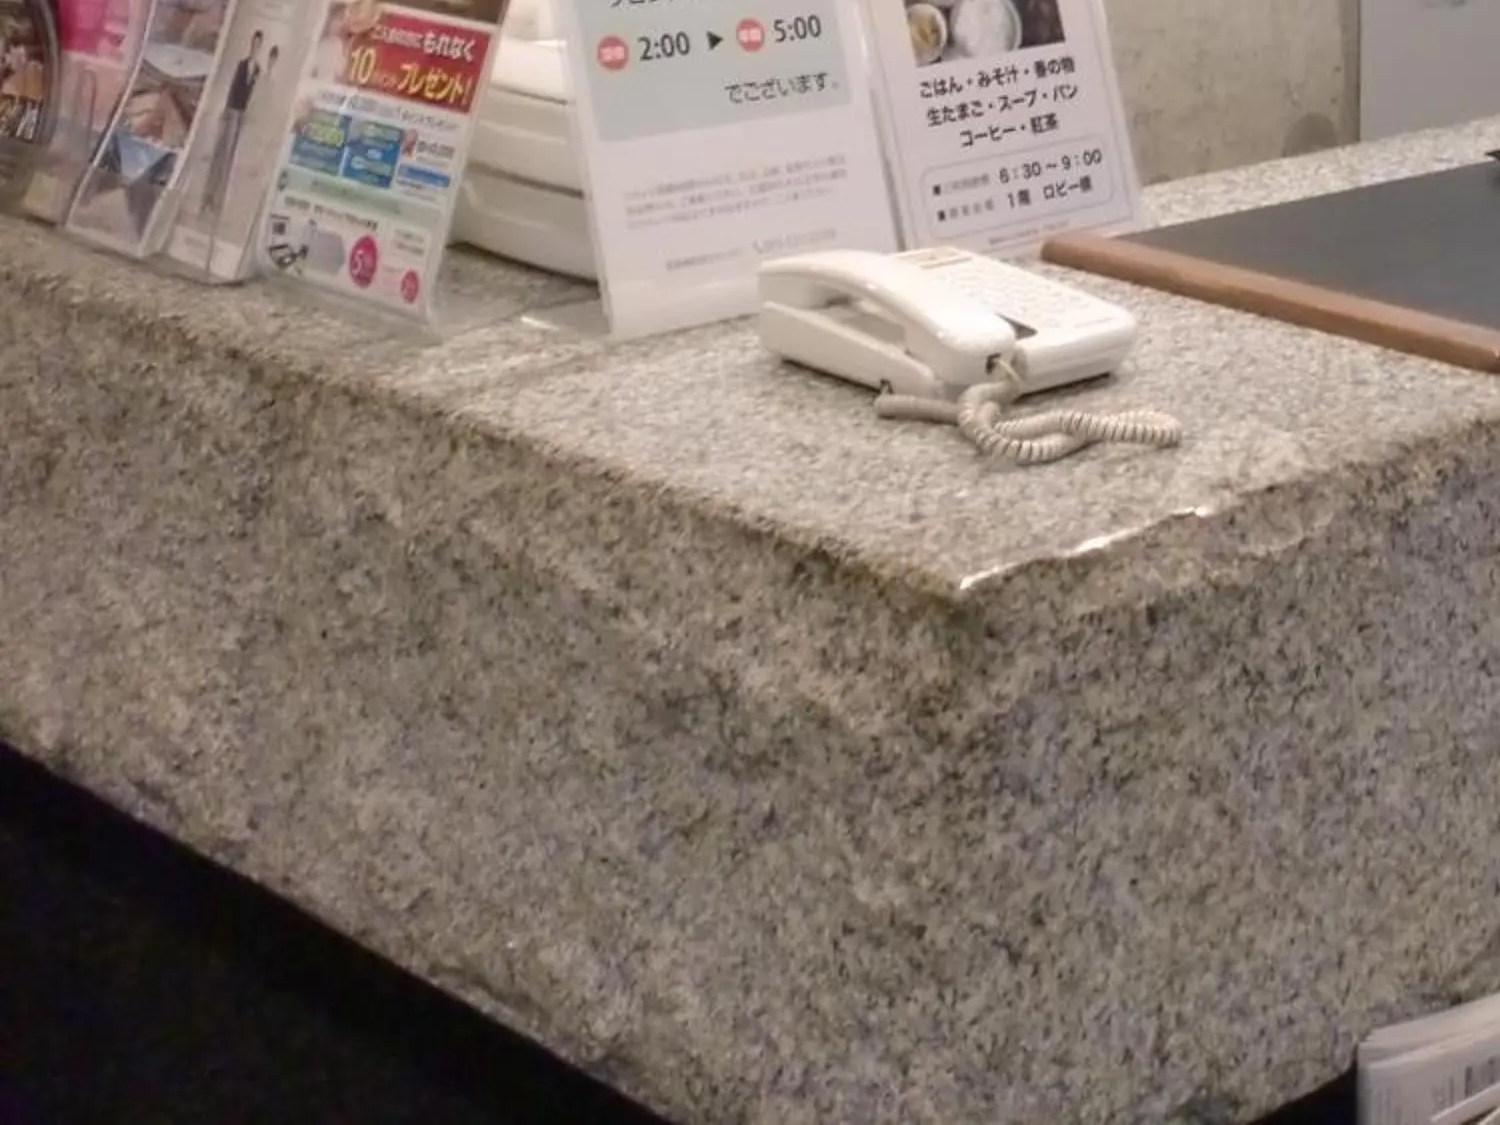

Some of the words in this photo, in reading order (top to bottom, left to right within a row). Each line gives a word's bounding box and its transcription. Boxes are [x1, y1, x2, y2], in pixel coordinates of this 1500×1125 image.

[424, 30, 476, 62] もれなく
[637, 31, 690, 62] 2:00
[773, 15, 822, 43] 5:00
